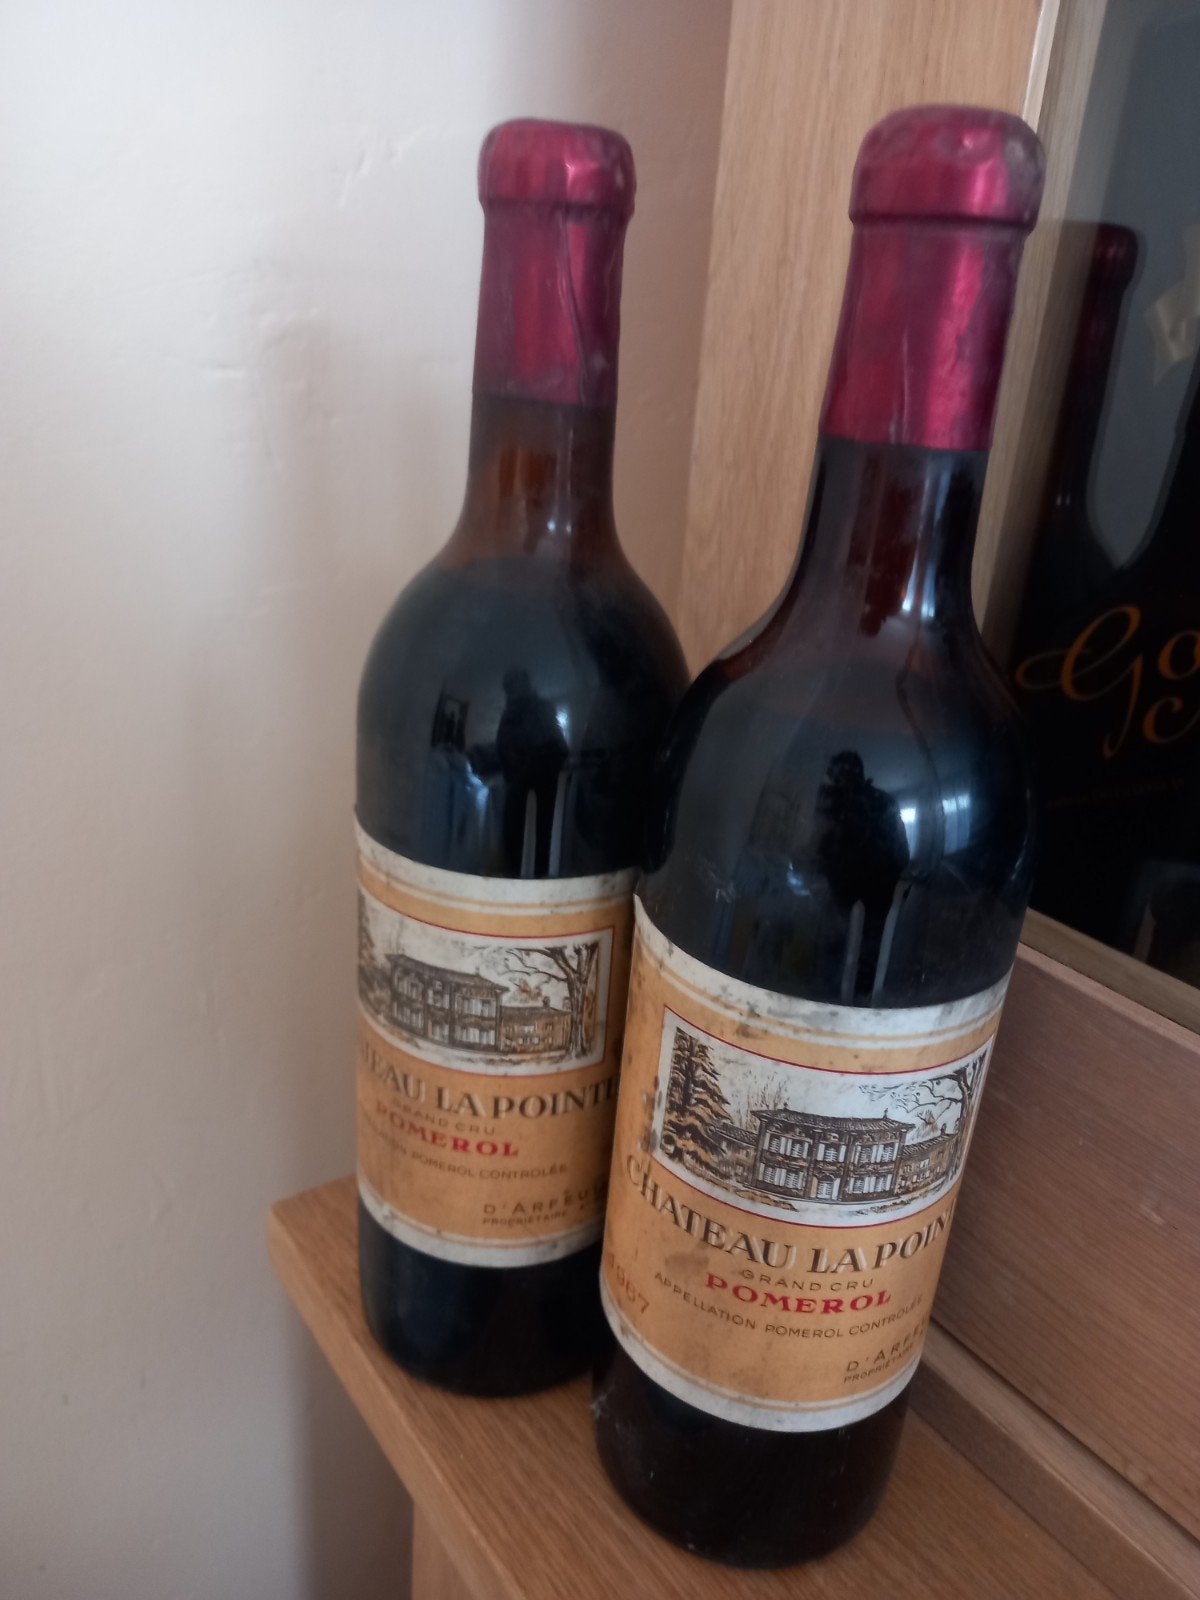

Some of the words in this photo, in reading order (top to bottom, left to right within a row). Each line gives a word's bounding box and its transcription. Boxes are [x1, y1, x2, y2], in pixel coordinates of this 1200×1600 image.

[436, 1086, 489, 1118] LA
[376, 1099, 519, 1158] POMEROL
[455, 1121, 496, 1136] CRU
[411, 1150, 475, 1178] POMEROL
[627, 1153, 797, 1270] CHATEAU
[808, 1245, 868, 1275] LA
[705, 1272, 892, 1316] POMEROL
[741, 1268, 822, 1292] GRAND
[830, 1277, 876, 1293] CRU
[654, 1271, 756, 1331] APPELLATION
[765, 1323, 844, 1340] POMEROL
